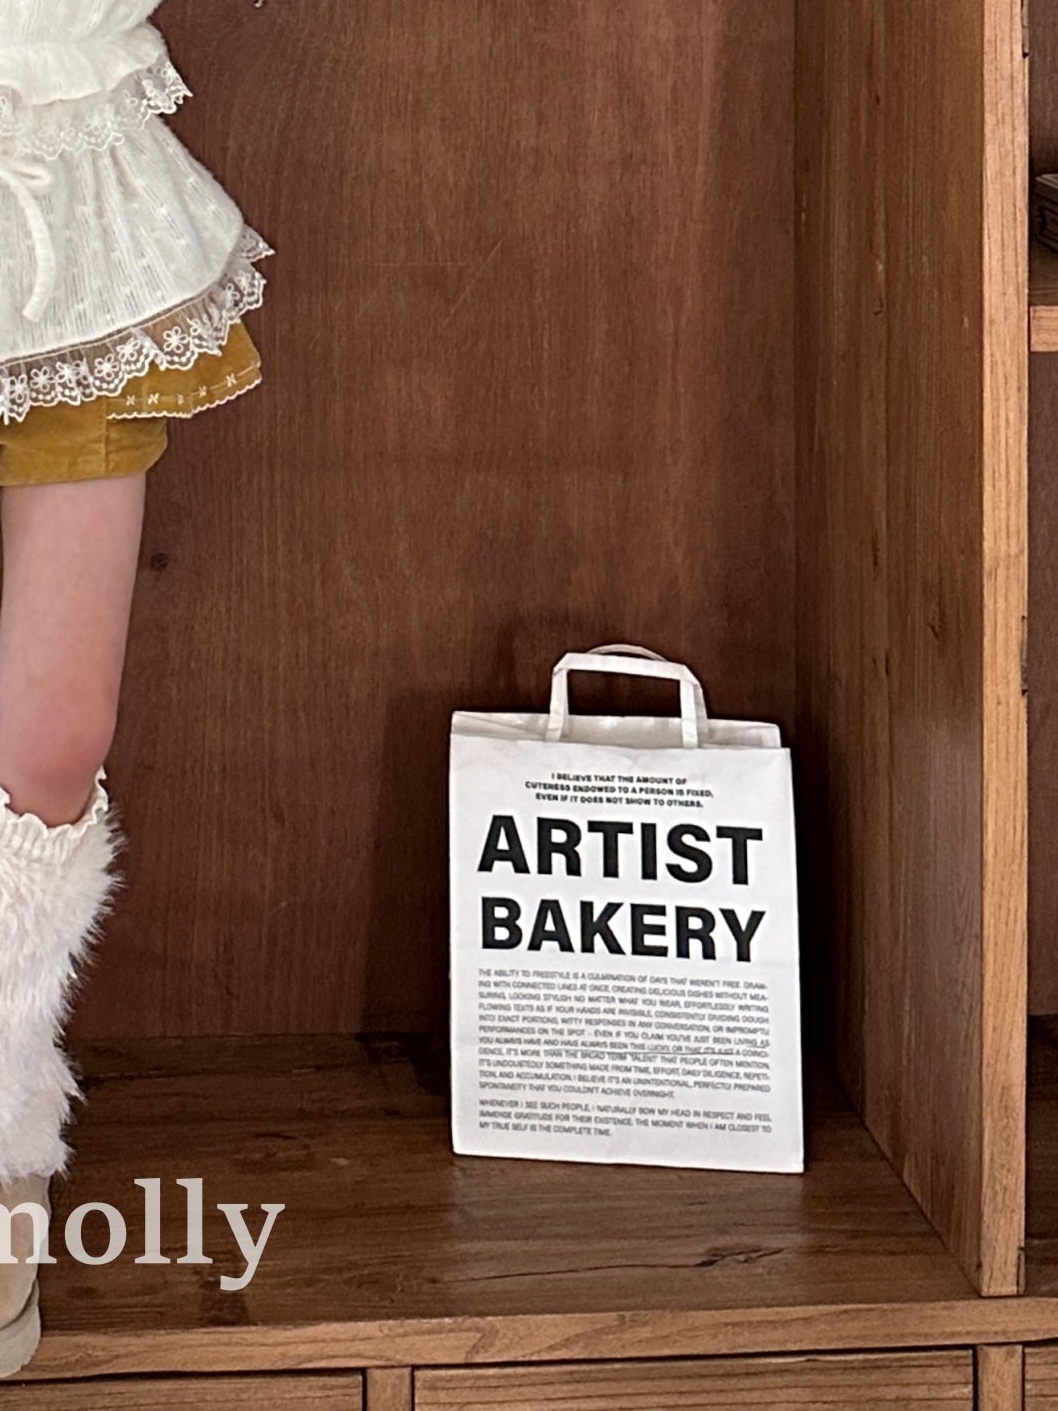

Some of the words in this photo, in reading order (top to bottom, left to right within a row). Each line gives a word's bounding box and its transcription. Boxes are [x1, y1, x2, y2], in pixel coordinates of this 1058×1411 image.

[556, 773, 592, 782] BELIEVE
[593, 774, 616, 782] THAT
[617, 775, 634, 783] THE
[635, 776, 674, 785] AMOUNT
[675, 777, 687, 785] OF
[572, 785, 616, 794] ENDOWED
[617, 786, 629, 794] TO
[639, 787, 674, 796] PERSON
[535, 792, 559, 801] EVEN
[560, 794, 568, 802] IF
[569, 795, 578, 803] IT
[580, 795, 604, 804] DOES
[605, 796, 623, 805] NOT
[625, 797, 652, 806] SHOW
[653, 798, 665, 806] TO
[477, 814, 764, 886] ARTIST
[481, 895, 767, 963] BAKERY
